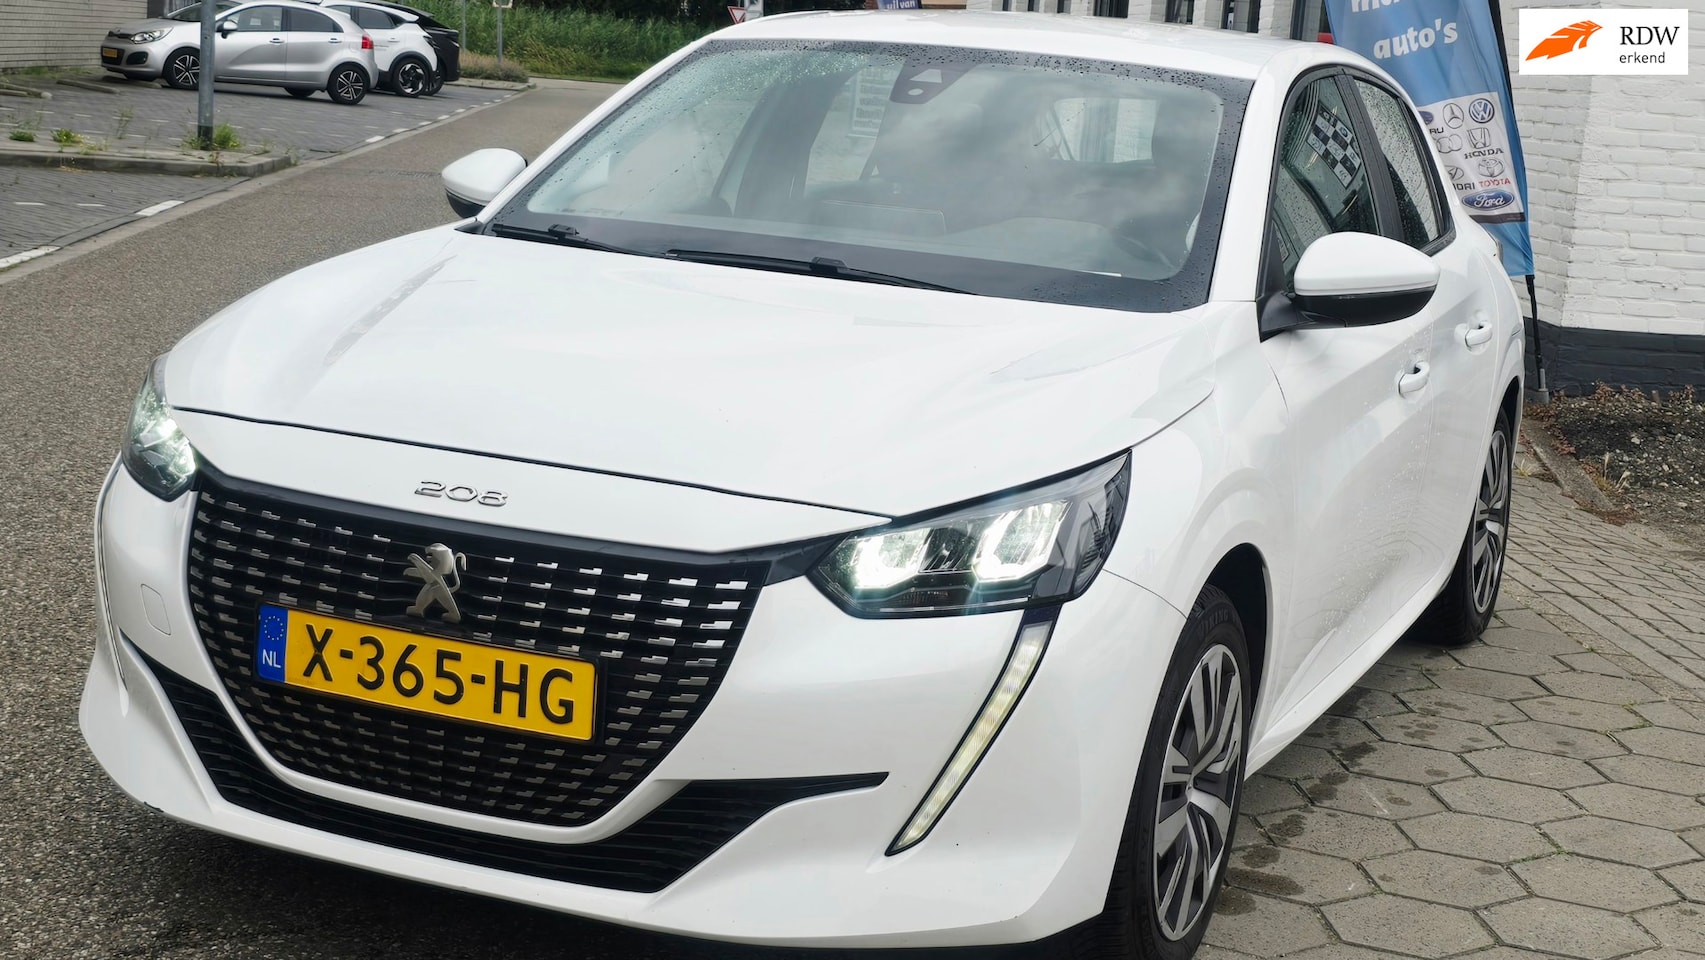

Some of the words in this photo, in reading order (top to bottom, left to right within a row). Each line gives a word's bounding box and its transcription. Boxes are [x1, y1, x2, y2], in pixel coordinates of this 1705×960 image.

[900, 0, 916, 9] van
[1373, 18, 1458, 59] auto's
[1464, 147, 1504, 160] HONDA
[1478, 177, 1511, 188] TOYOTA
[1474, 192, 1505, 207] Ford
[414, 480, 509, 507] 208
[262, 648, 282, 669] NL
[303, 624, 574, 725] X-365-HG
